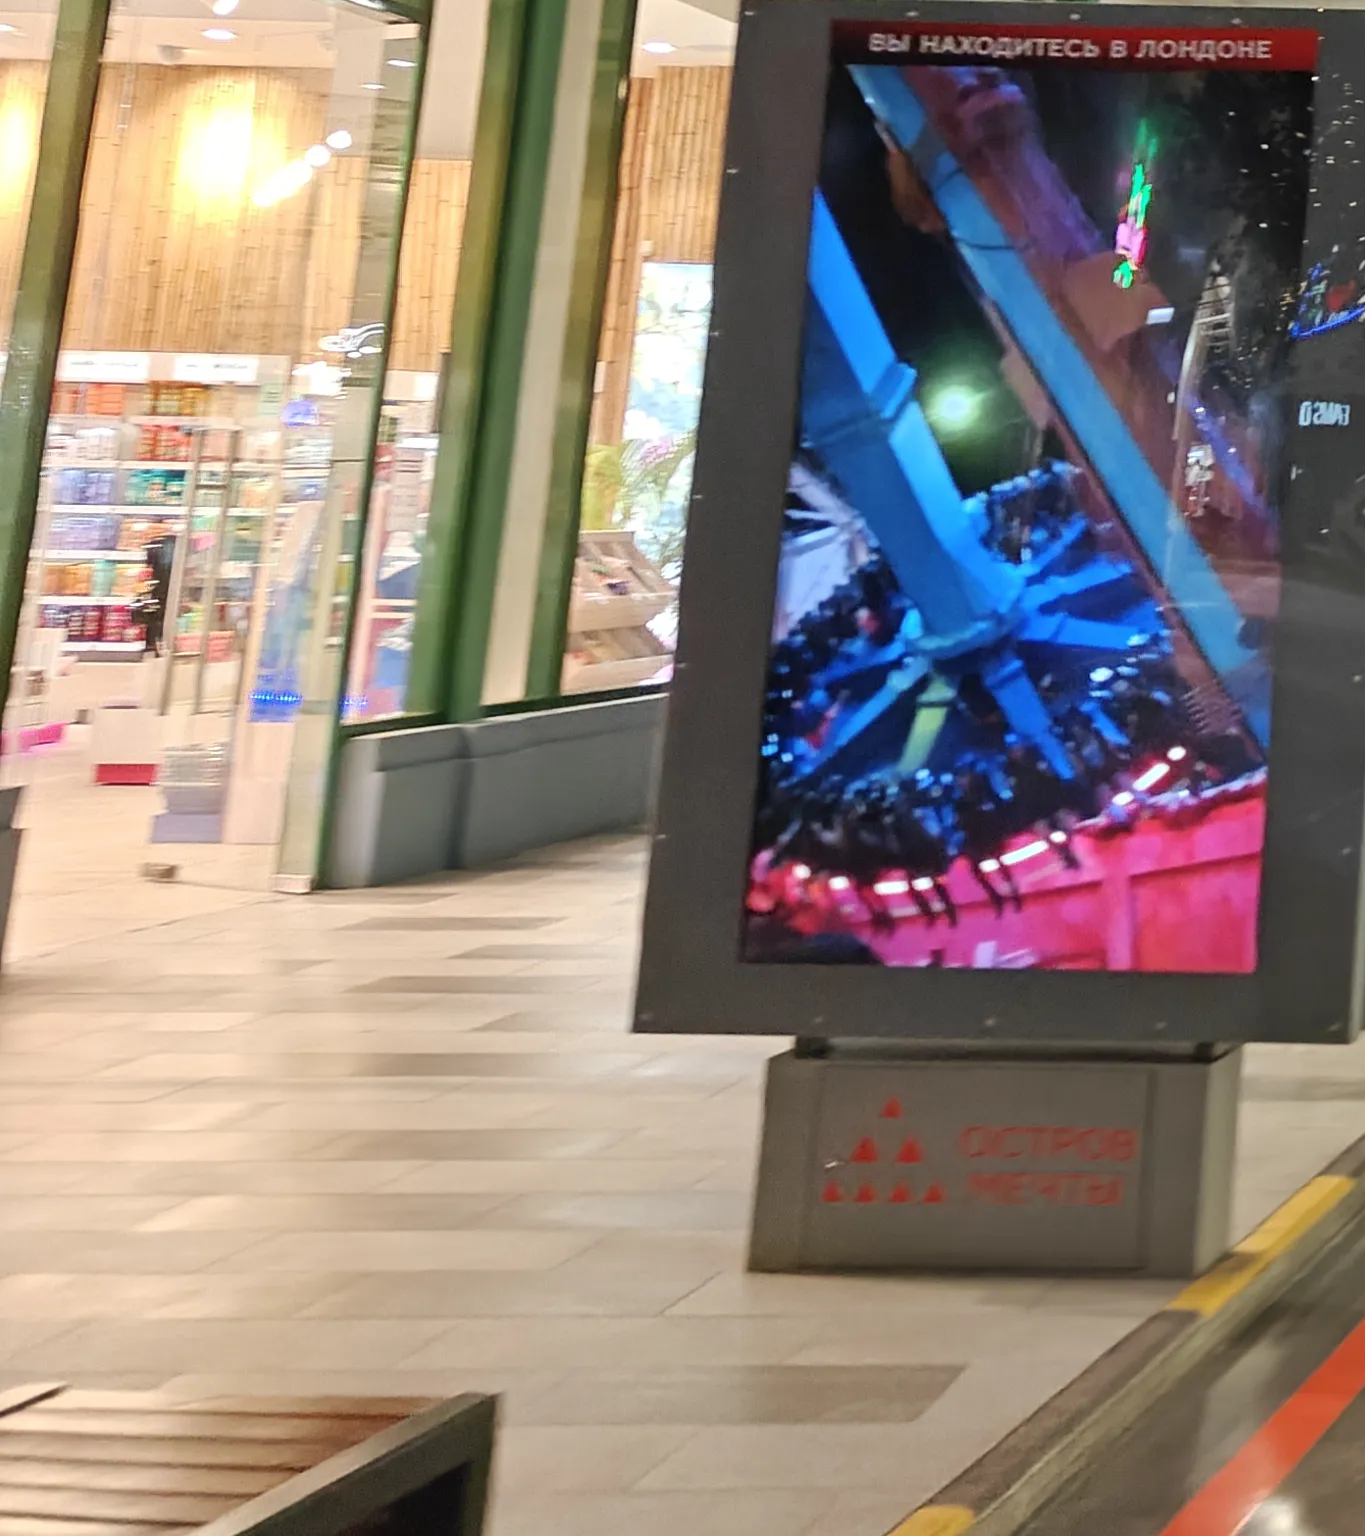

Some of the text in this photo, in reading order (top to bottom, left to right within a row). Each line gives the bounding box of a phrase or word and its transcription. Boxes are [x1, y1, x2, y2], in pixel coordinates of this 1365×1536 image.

[868, 32, 1273, 62] ВЫ НАХОДИТЕСЬ В ЛОНДОНЕ
[958, 1125, 1141, 1163] ОСТРОВ
[966, 1172, 1125, 1207] МЕЧТЫ
